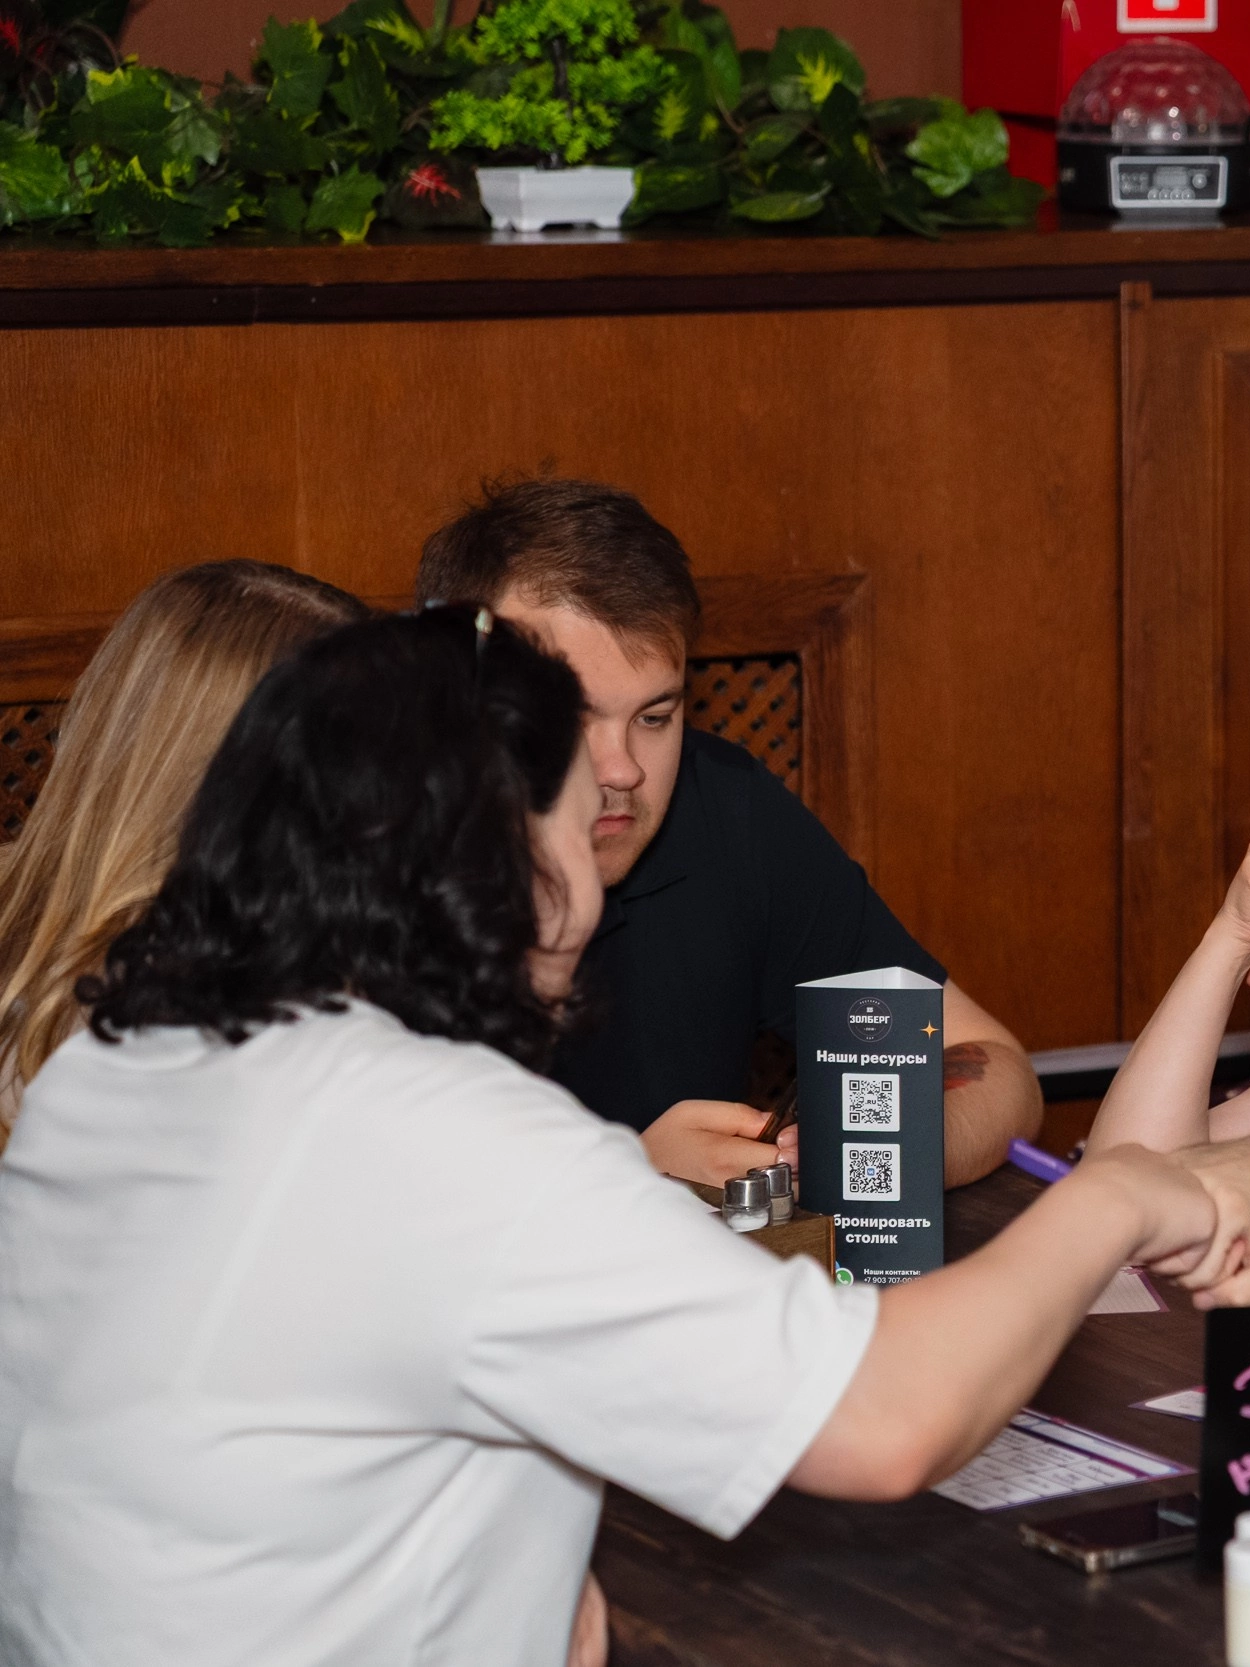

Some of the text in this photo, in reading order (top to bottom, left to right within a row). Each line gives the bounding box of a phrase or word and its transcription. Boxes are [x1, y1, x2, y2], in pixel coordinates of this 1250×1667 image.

[849, 1015, 891, 1025] ЗОЛБЕРГ
[816, 1050, 927, 1067] Наши ресурсы
[833, 1213, 931, 1230] бронировать
[845, 1233, 898, 1244] столик
